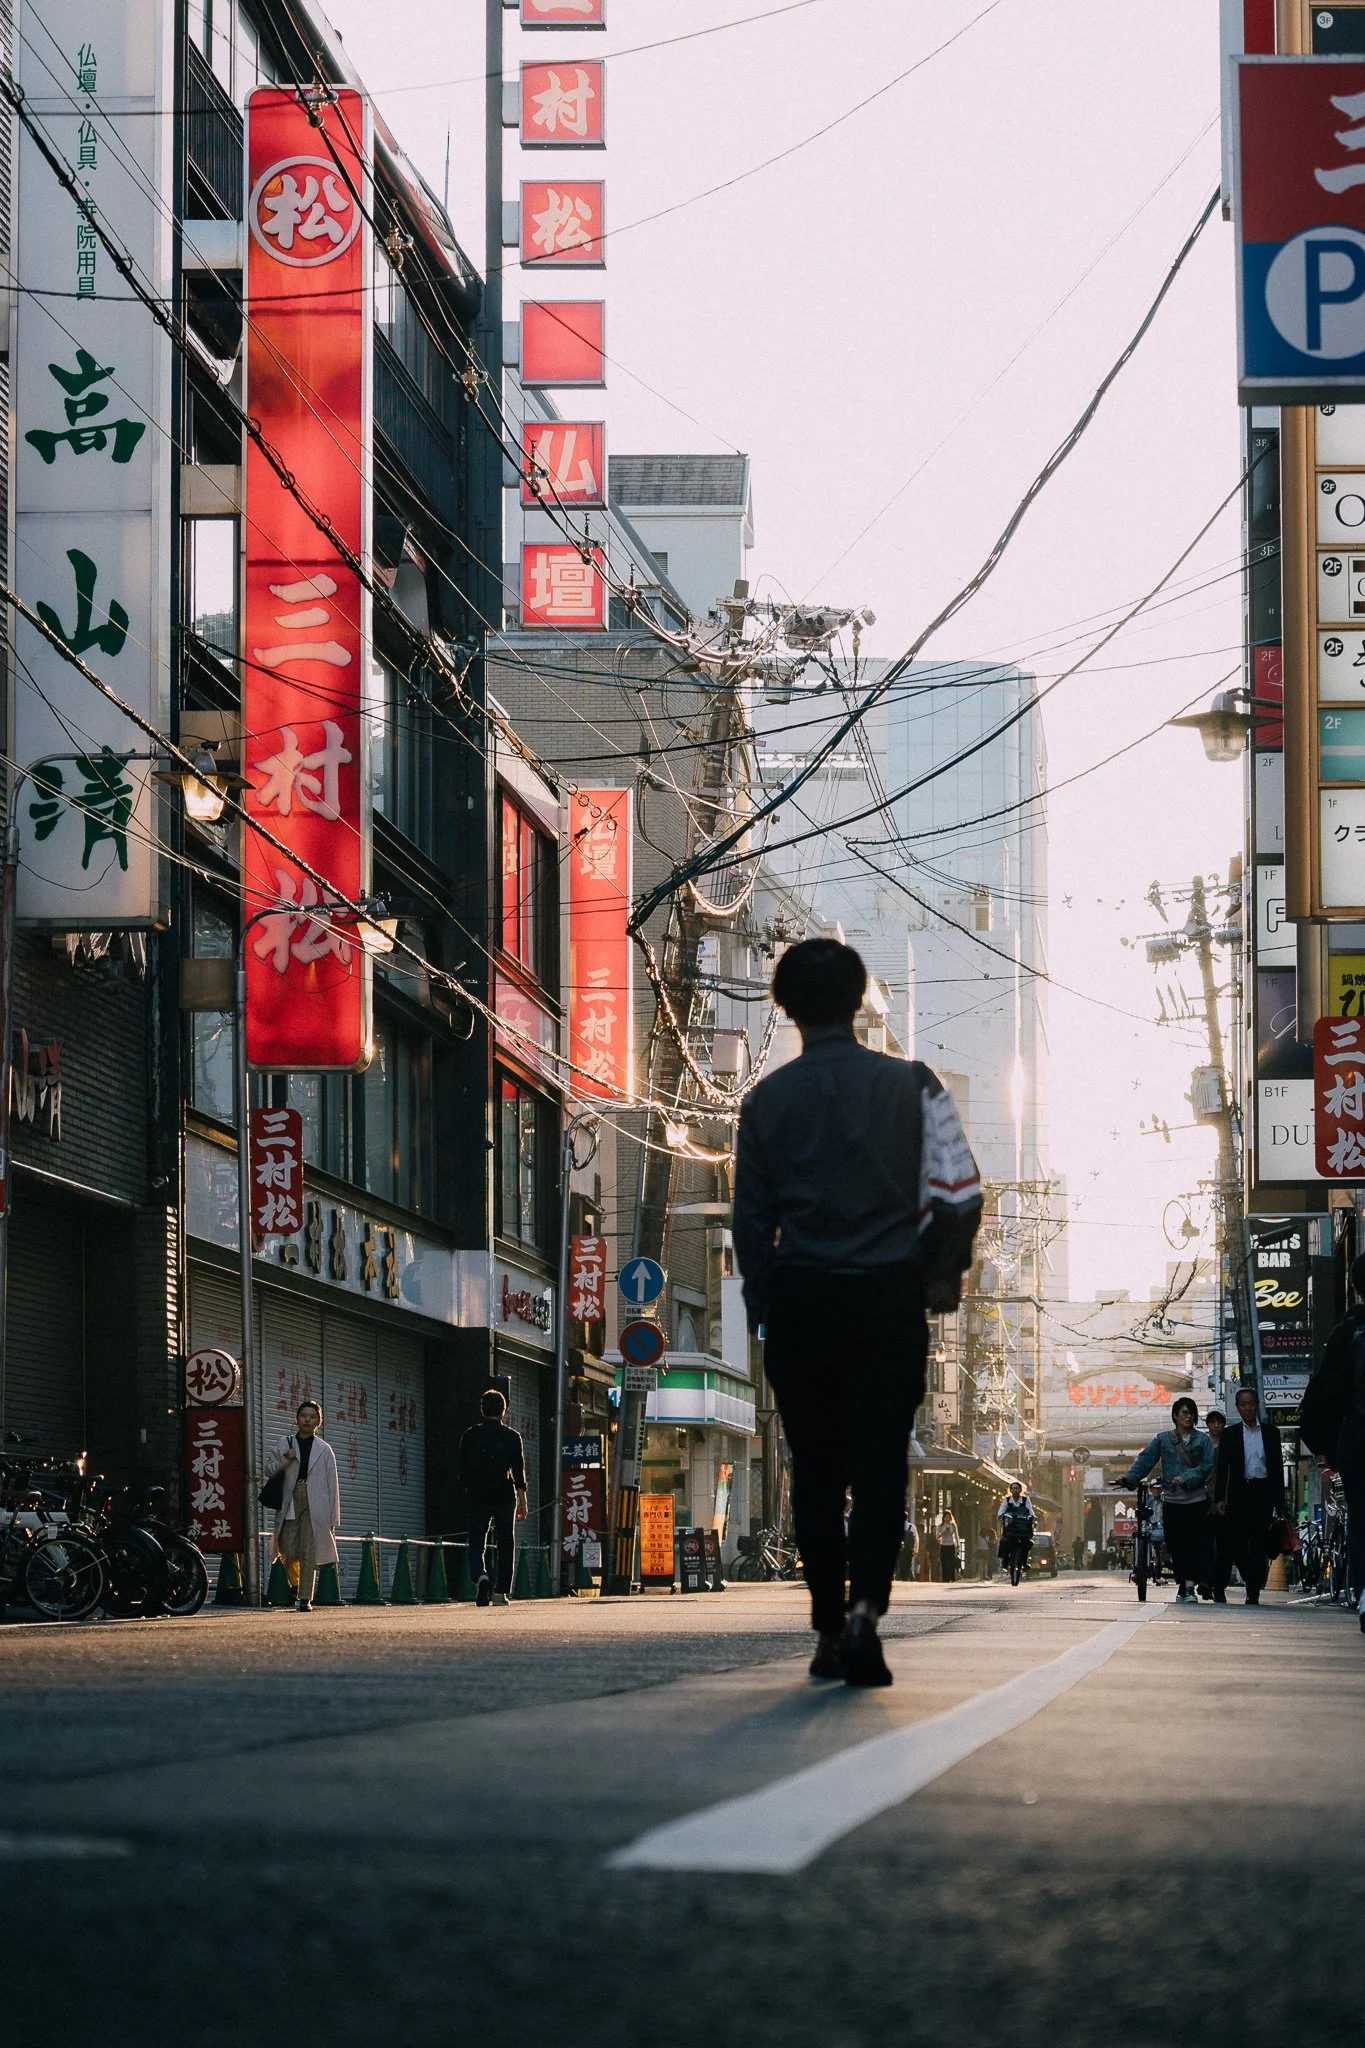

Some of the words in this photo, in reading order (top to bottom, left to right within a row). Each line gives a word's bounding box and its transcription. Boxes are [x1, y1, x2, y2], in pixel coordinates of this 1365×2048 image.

[1318, 14, 1332, 25] 3F
[75, 43, 98, 301] 仏壇・仏具・寺院用具
[262, 173, 350, 249] 松
[1323, 482, 1336, 492] 2F
[1260, 546, 1275, 556] 3F
[1325, 560, 1341, 573] 2F
[1261, 652, 1275, 661] 2F
[1326, 639, 1343, 654] 2F
[1325, 716, 1342, 730] 2F
[1262, 758, 1275, 767] 2F
[252, 573, 353, 974] 三村松
[1328, 798, 1338, 808] 1F
[579, 804, 618, 881] 仏壇
[1264, 870, 1277, 880] 1F
[578, 967, 618, 1083] 三村松
[1265, 1087, 1288, 1098] B1F
[1323, 1020, 1365, 1175] 三村松
[1271, 1125, 1316, 1146] DU
[256, 1111, 299, 1231] 三村松
[1258, 1253, 1291, 1268] BAR
[572, 1238, 604, 1322] 三村松
[1254, 1279, 1303, 1308] Bee
[187, 1359, 230, 1395] 松
[1068, 1384, 1172, 1405] キリンビール
[192, 1419, 226, 1513] 三村松
[562, 1474, 597, 1557] 三村松
